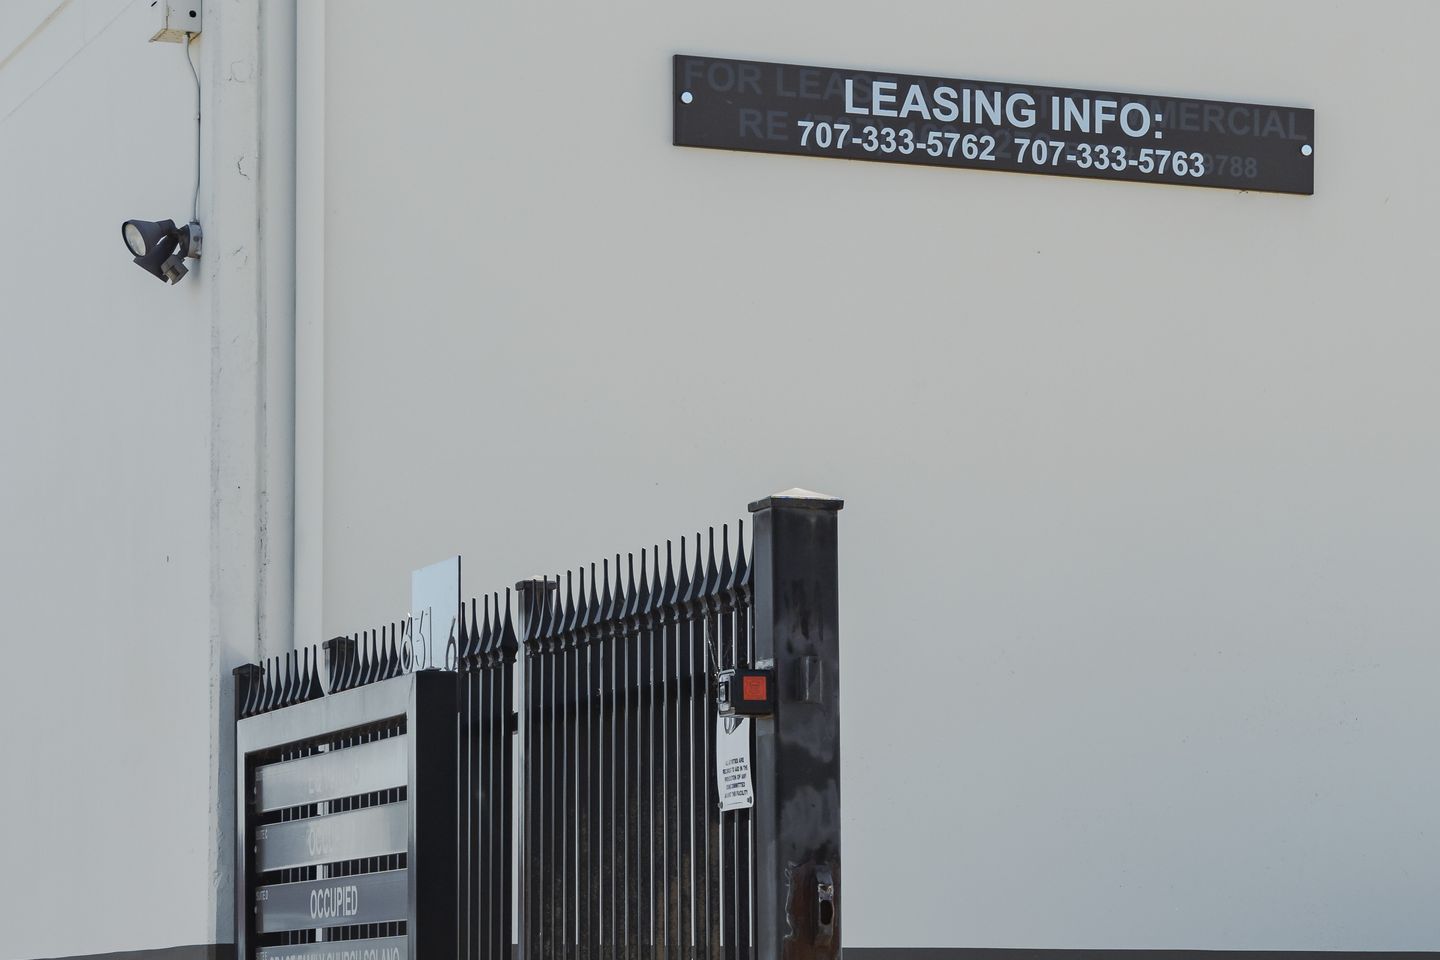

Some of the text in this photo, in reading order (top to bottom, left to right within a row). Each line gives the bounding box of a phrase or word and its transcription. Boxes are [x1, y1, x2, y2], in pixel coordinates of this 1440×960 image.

[843, 78, 1163, 140] LEASING INFO:
[797, 119, 1206, 178] 707-333-5762 707-333-5763
[310, 885, 358, 919] OCCUPIED
